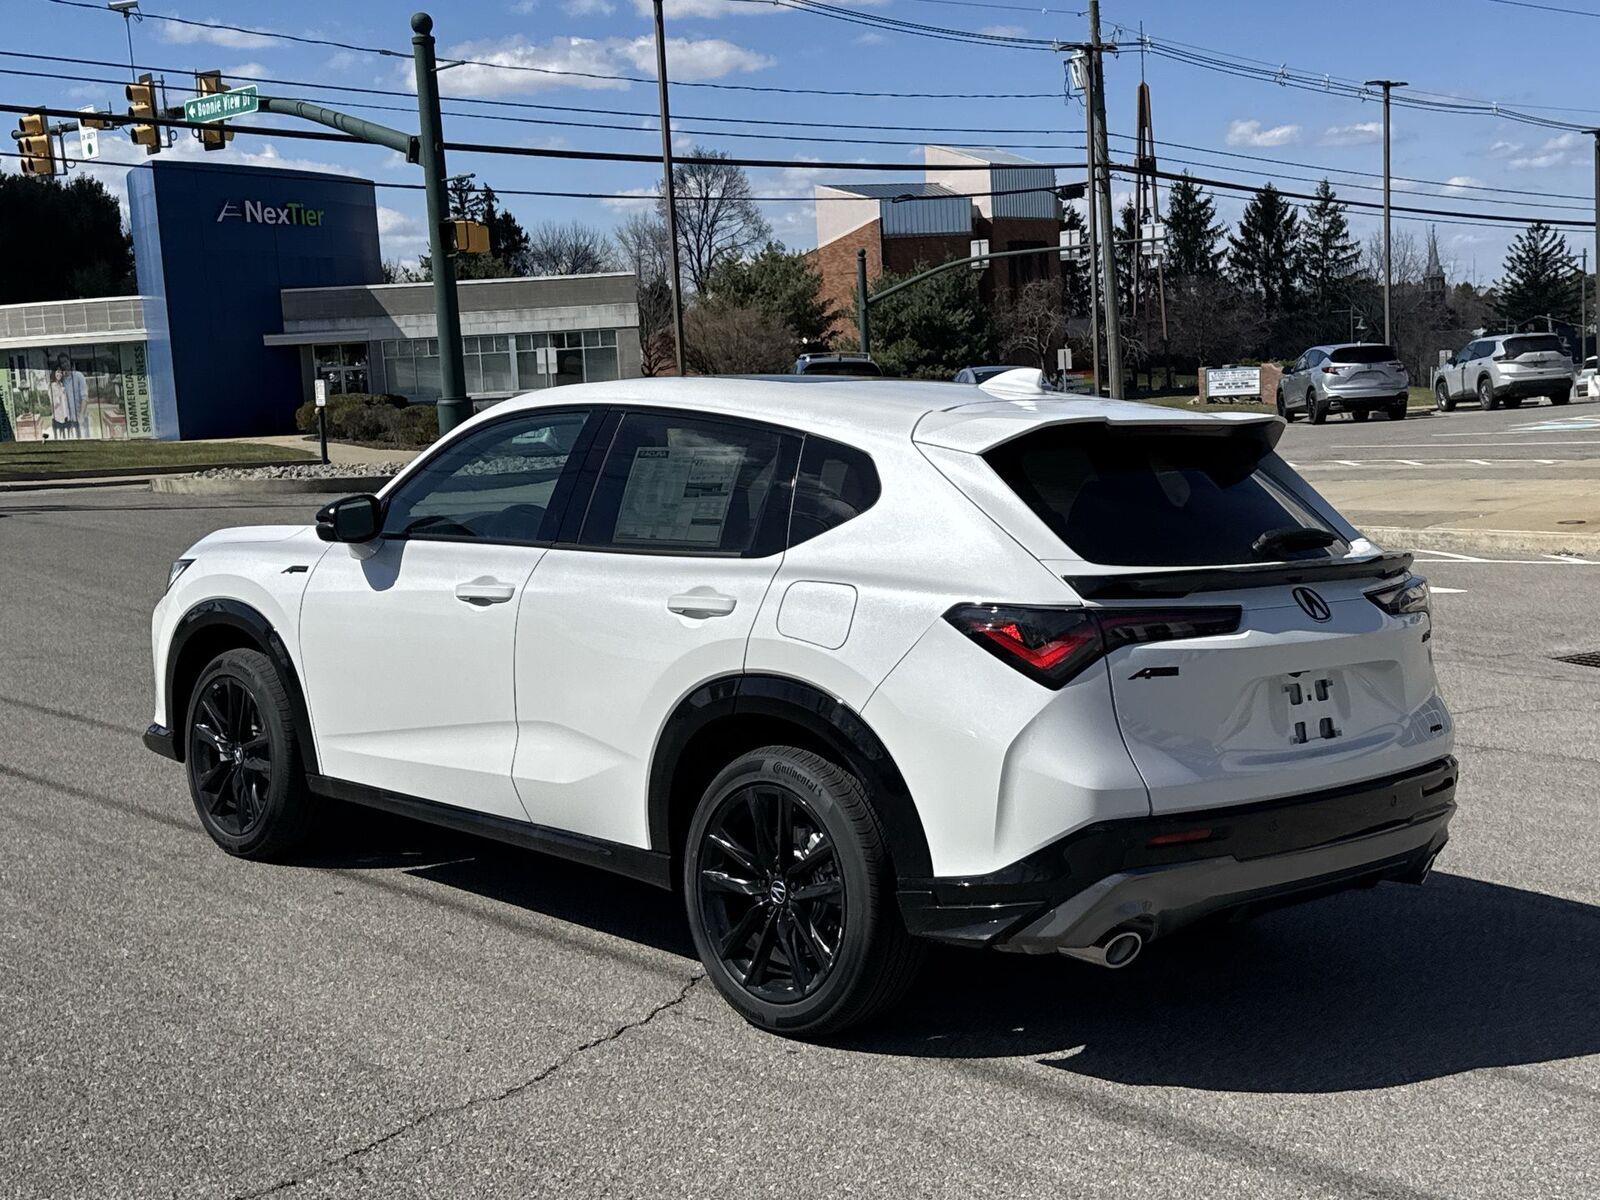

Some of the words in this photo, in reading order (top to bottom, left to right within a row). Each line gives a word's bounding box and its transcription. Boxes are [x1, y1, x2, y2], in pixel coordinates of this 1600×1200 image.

[197, 98, 221, 117] Bonnie
[222, 94, 241, 111] View
[242, 92, 251, 106] Dr
[245, 200, 325, 226] NexTier
[134, 346, 147, 396] BUSINESS
[125, 367, 139, 433] COMMERCIAL
[140, 401, 151, 433] SMALL
[773, 761, 818, 792] Continental
